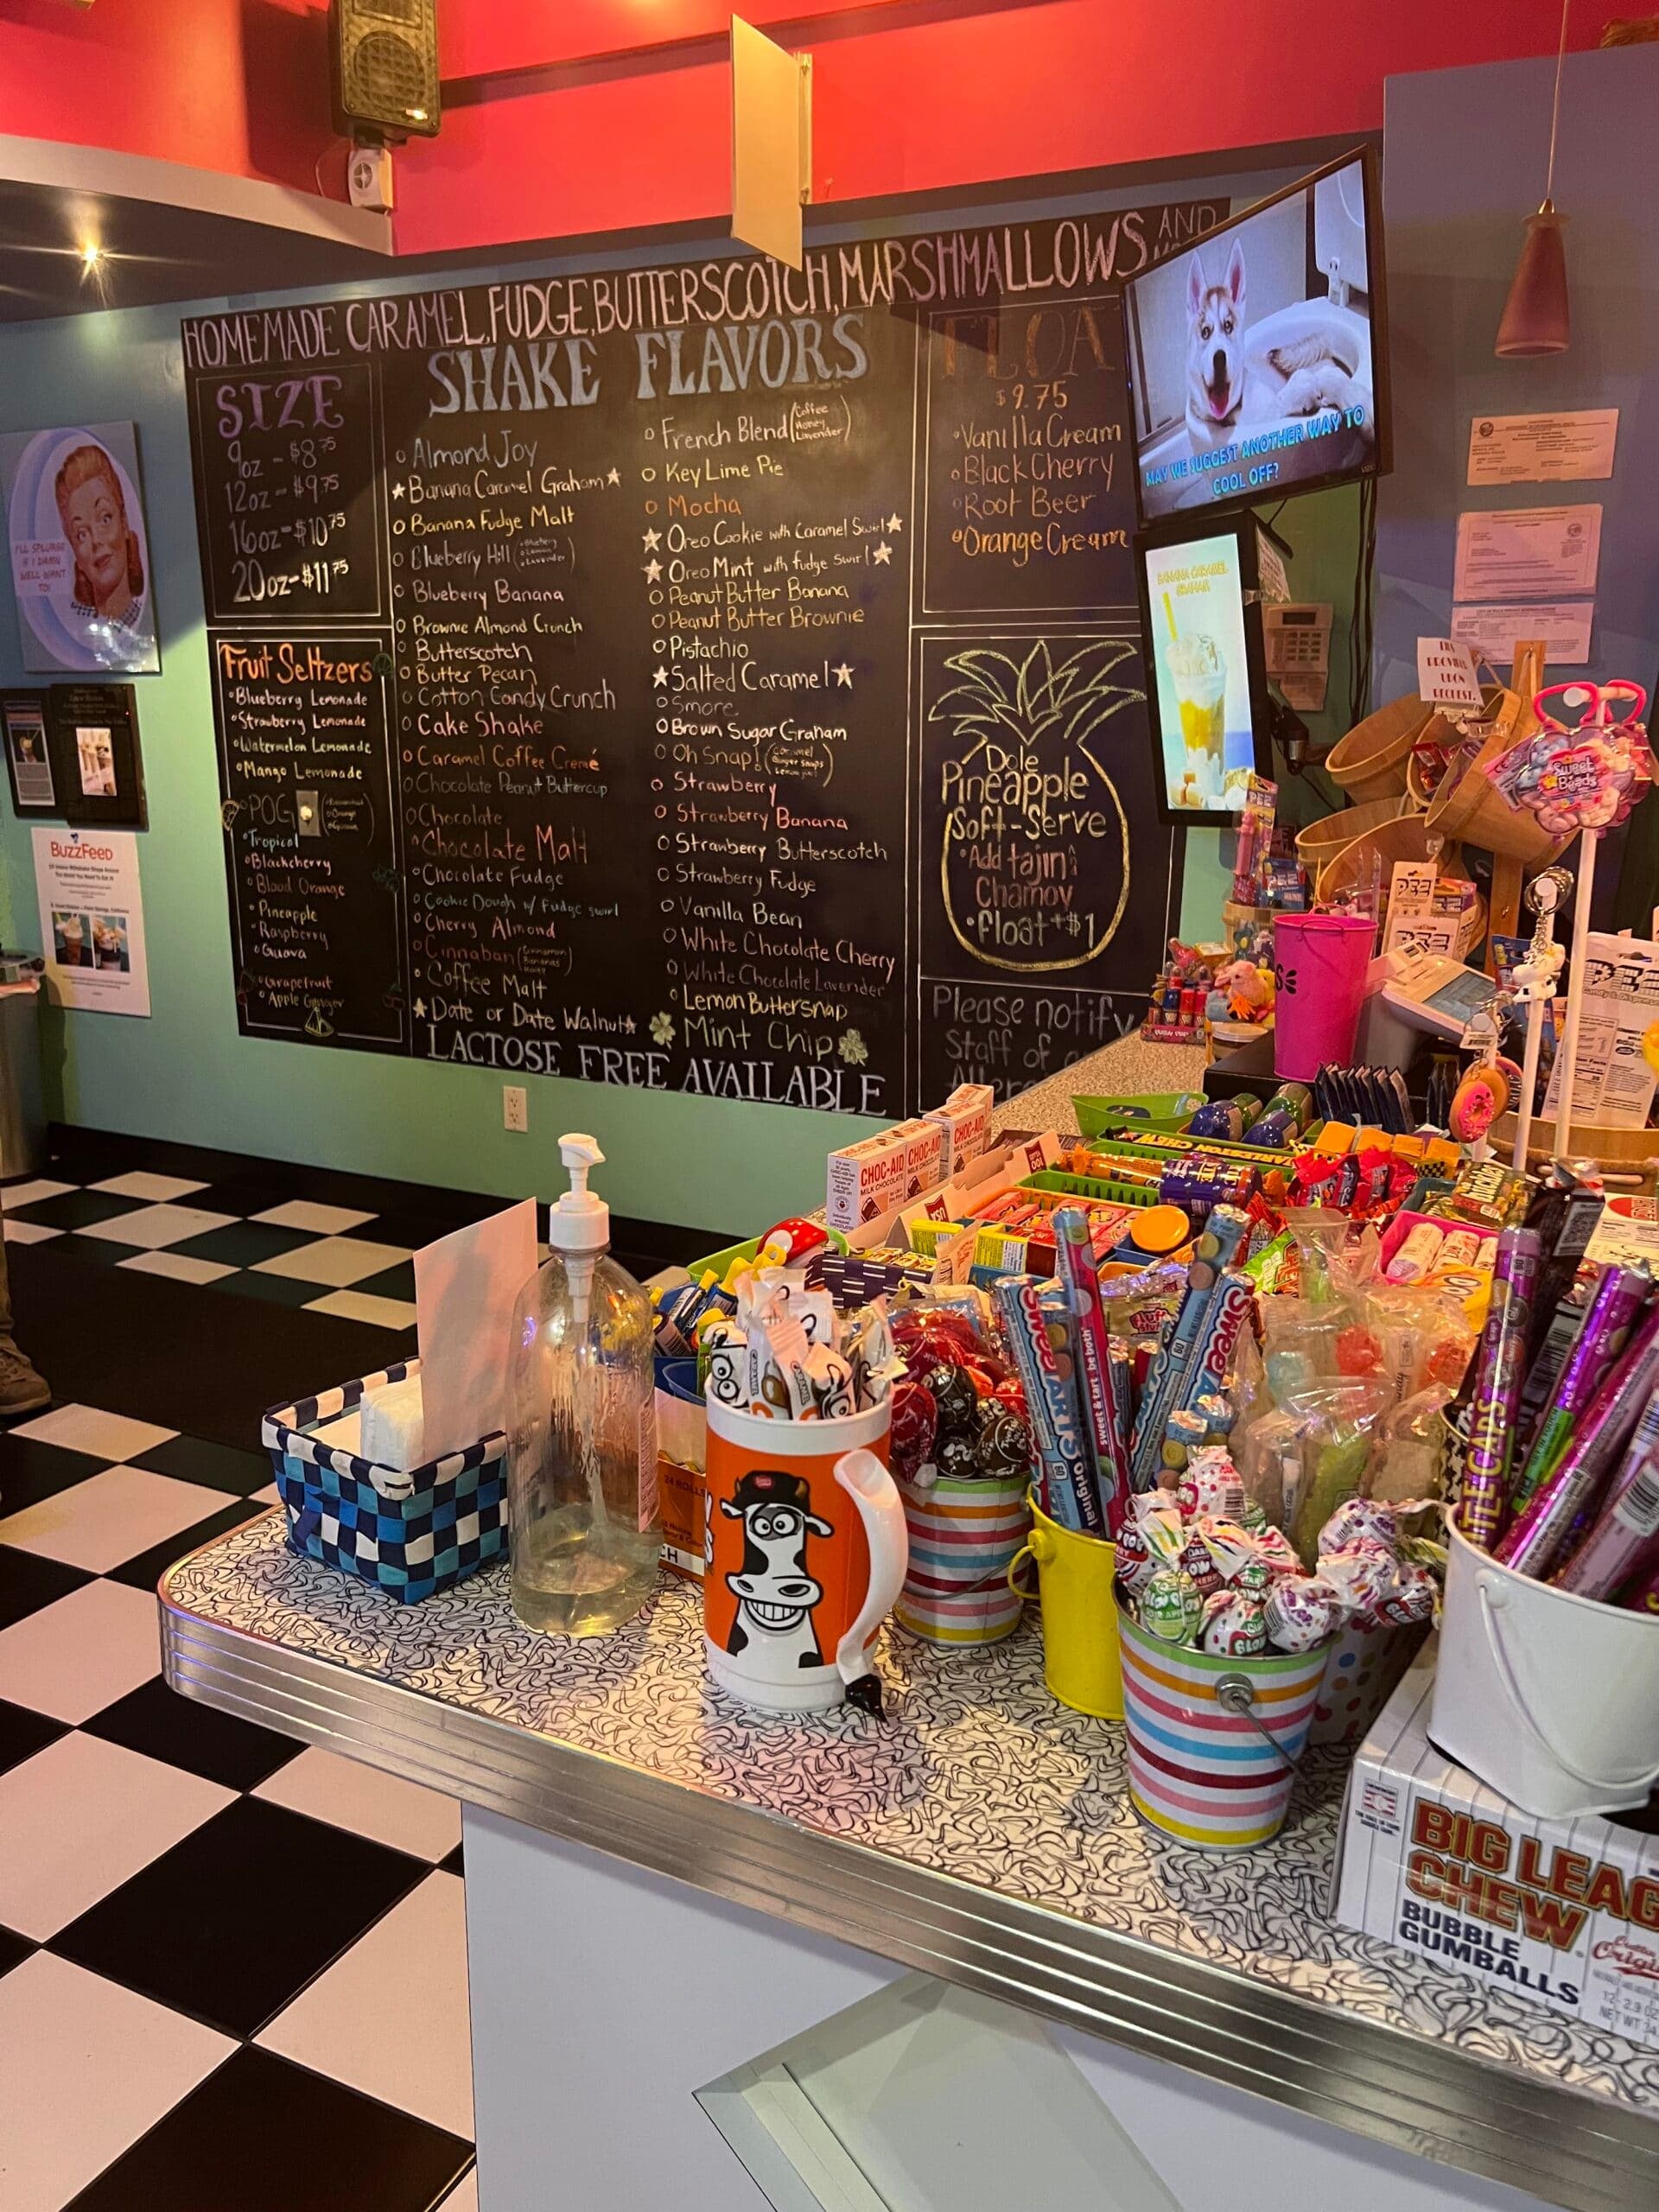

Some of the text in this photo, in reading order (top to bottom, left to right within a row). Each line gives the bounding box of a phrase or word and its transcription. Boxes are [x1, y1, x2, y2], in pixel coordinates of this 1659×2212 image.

[182, 306, 340, 369] HOMEMADE
[838, 211, 1147, 308] MARSHMALLOWS
[1158, 205, 1216, 239] AND
[427, 314, 868, 416] SHAKE FLAVORS
[216, 374, 344, 439] SIZE
[995, 380, 1070, 410] $9.75
[661, 413, 789, 450] French Blend
[961, 413, 1122, 449] Vanilla Cream
[1145, 406, 1365, 486] MAY WE SUGGEST ANOTHER WAY TO
[413, 429, 538, 469] Almond Joy
[665, 454, 785, 488] Key Lime Pie
[964, 452, 1114, 493] Black Cherry
[1212, 462, 1280, 496] COOL OFF?
[225, 480, 272, 513] 12oz
[667, 491, 742, 518] Mocha
[964, 485, 1096, 520] Root Beer
[229, 520, 283, 554] 16oz
[410, 505, 575, 537] Banana Fudge Malt
[667, 523, 711, 553] Oreo
[713, 520, 764, 546] Cookie
[963, 522, 1130, 568] Orange Cream
[232, 559, 292, 603] 20oz
[668, 556, 789, 583] Oreo Mint with
[494, 578, 564, 603] Banana
[474, 615, 528, 635] Almond
[219, 643, 373, 684] Fruit Seltzers
[415, 638, 533, 663] Butterscotch
[669, 635, 749, 660] Pistachio
[477, 664, 538, 686] Pecan
[671, 659, 830, 693] Salted Caramel
[1440, 672, 1465, 684] UPON
[236, 686, 368, 710] Blueberry Lemonade
[550, 678, 616, 710] Crunch
[238, 710, 366, 735] Strawberry Lemonade
[417, 710, 544, 738] Cake Shake
[671, 718, 848, 747] Brown Sugar Graham
[240, 736, 372, 754] Watermelon Lemonade
[985, 744, 1039, 772] Dole
[244, 761, 363, 783] Mango Lemonade
[1553, 756, 1596, 778] Sweet
[1557, 772, 1599, 791] Beads
[673, 771, 777, 807] Strawberry
[941, 756, 1090, 820] Pineapple
[1249, 791, 1273, 806] PEZ
[249, 794, 296, 830] POG
[777, 807, 849, 830] Banana
[50, 841, 113, 861] BuzzFeed
[249, 830, 299, 853] Tropical
[676, 832, 887, 863] Strawberry Butterscotch
[969, 842, 1002, 872] Add
[257, 874, 291, 894] Blood
[676, 861, 817, 898] Strawberry Fudge
[1395, 877, 1434, 899] PEZ
[258, 899, 318, 925] Pineapple
[424, 893, 468, 910] Cookie
[680, 896, 803, 930] Vanilla Bean
[259, 922, 329, 950] Raspberry
[262, 944, 308, 960] Guava
[681, 926, 895, 984] White Cherry
[683, 983, 746, 1010] Lemon
[933, 984, 1135, 1040] Please notify
[486, 1007, 505, 1022] or
[683, 1015, 833, 1063] Mint Chip
[944, 1028, 1013, 1067] Staff
[1022, 1033, 1052, 1070] of
[426, 1023, 563, 1077] LACTOSE
[577, 1043, 670, 1090] FREE
[679, 1057, 887, 1117] AVAILABLE
[953, 1115, 985, 1145] CHOC-AID
[907, 1134, 941, 1167] CHOC-AID
[1134, 1133, 1294, 1166] ARLESTON CHEW
[860, 1154, 905, 1187] CHOC-AID
[860, 1173, 905, 1197] MILK CHOCOLATE
[1082, 1329, 1097, 1354] both
[749, 1349, 759, 1397] CARAMEL
[1087, 1356, 1097, 1370] be
[790, 1360, 810, 1406] CARAMEL
[1090, 1375, 1101, 1395] tart
[1093, 1414, 1108, 1446] sweet
[1467, 1399, 1506, 1476] CAPS
[1073, 1462, 1097, 1528] Original
[1411, 1796, 1659, 1934] BIG LEAG
[1405, 1848, 1590, 1953] CHEW
[1402, 1897, 1520, 1961] BUBBLE
[1398, 1922, 1580, 2005] GUMBALLS
